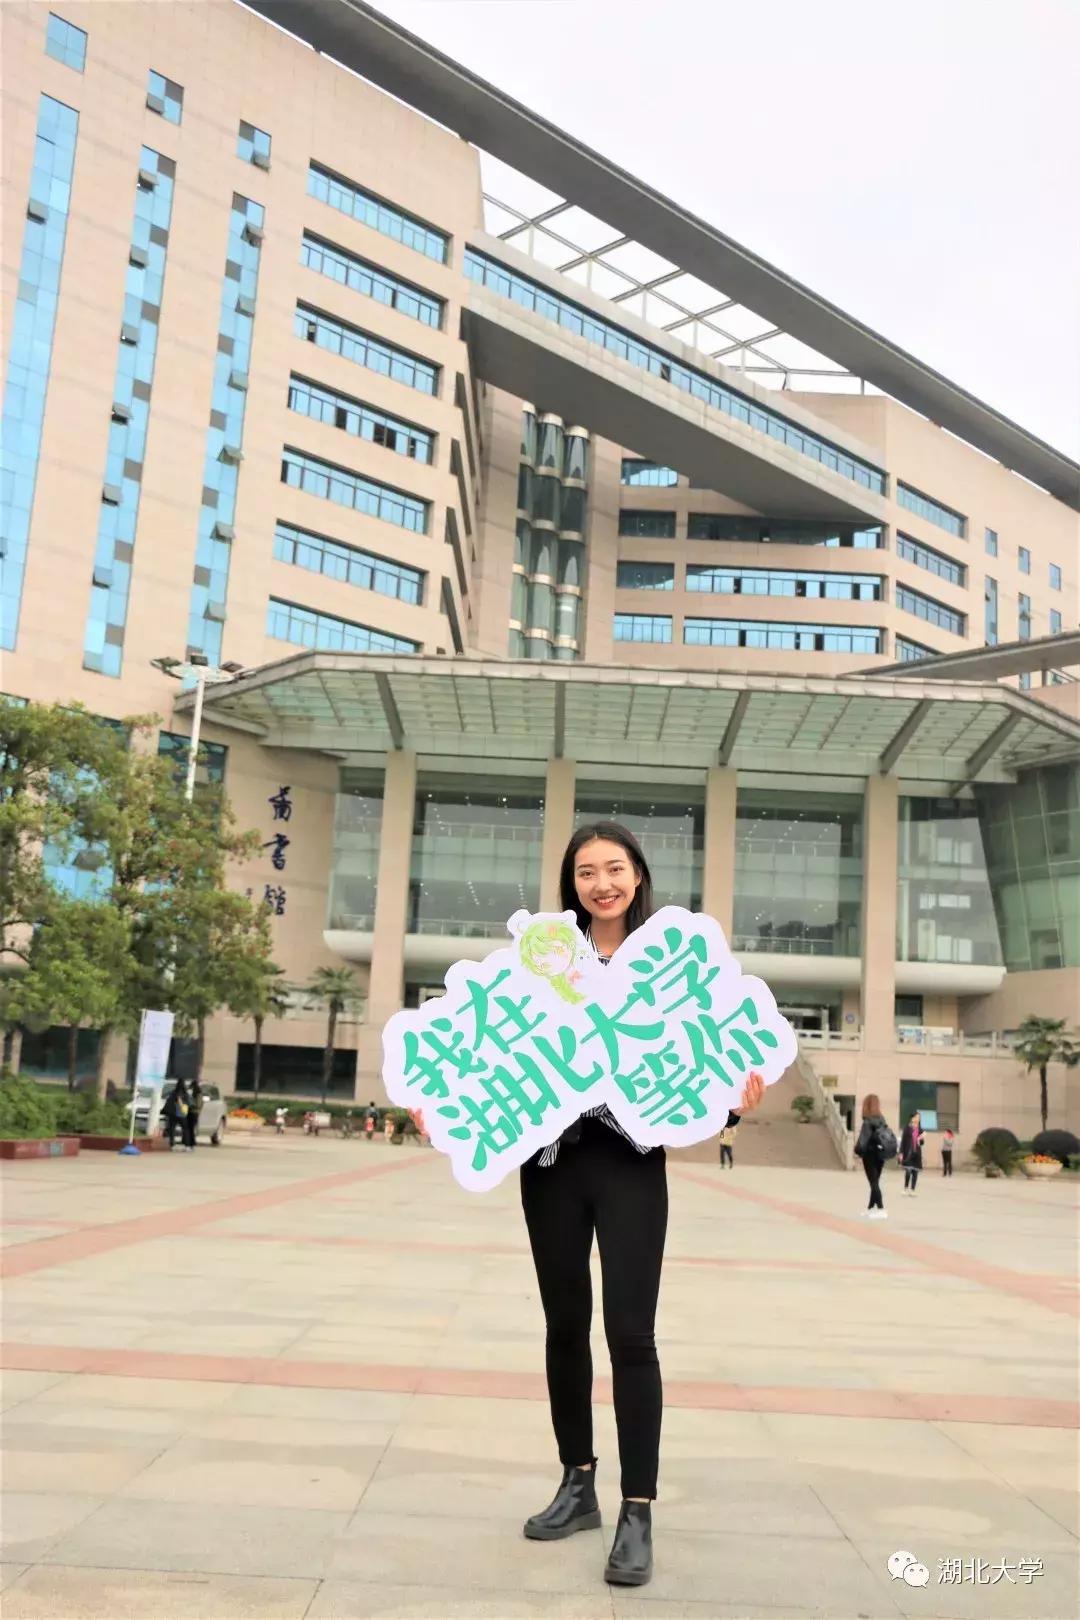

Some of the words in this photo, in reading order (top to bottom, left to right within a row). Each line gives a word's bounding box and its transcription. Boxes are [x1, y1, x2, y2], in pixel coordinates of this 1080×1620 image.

[403, 968, 548, 1099] 我在
[436, 927, 721, 1172] 湖北大学
[613, 996, 779, 1128] 等你
